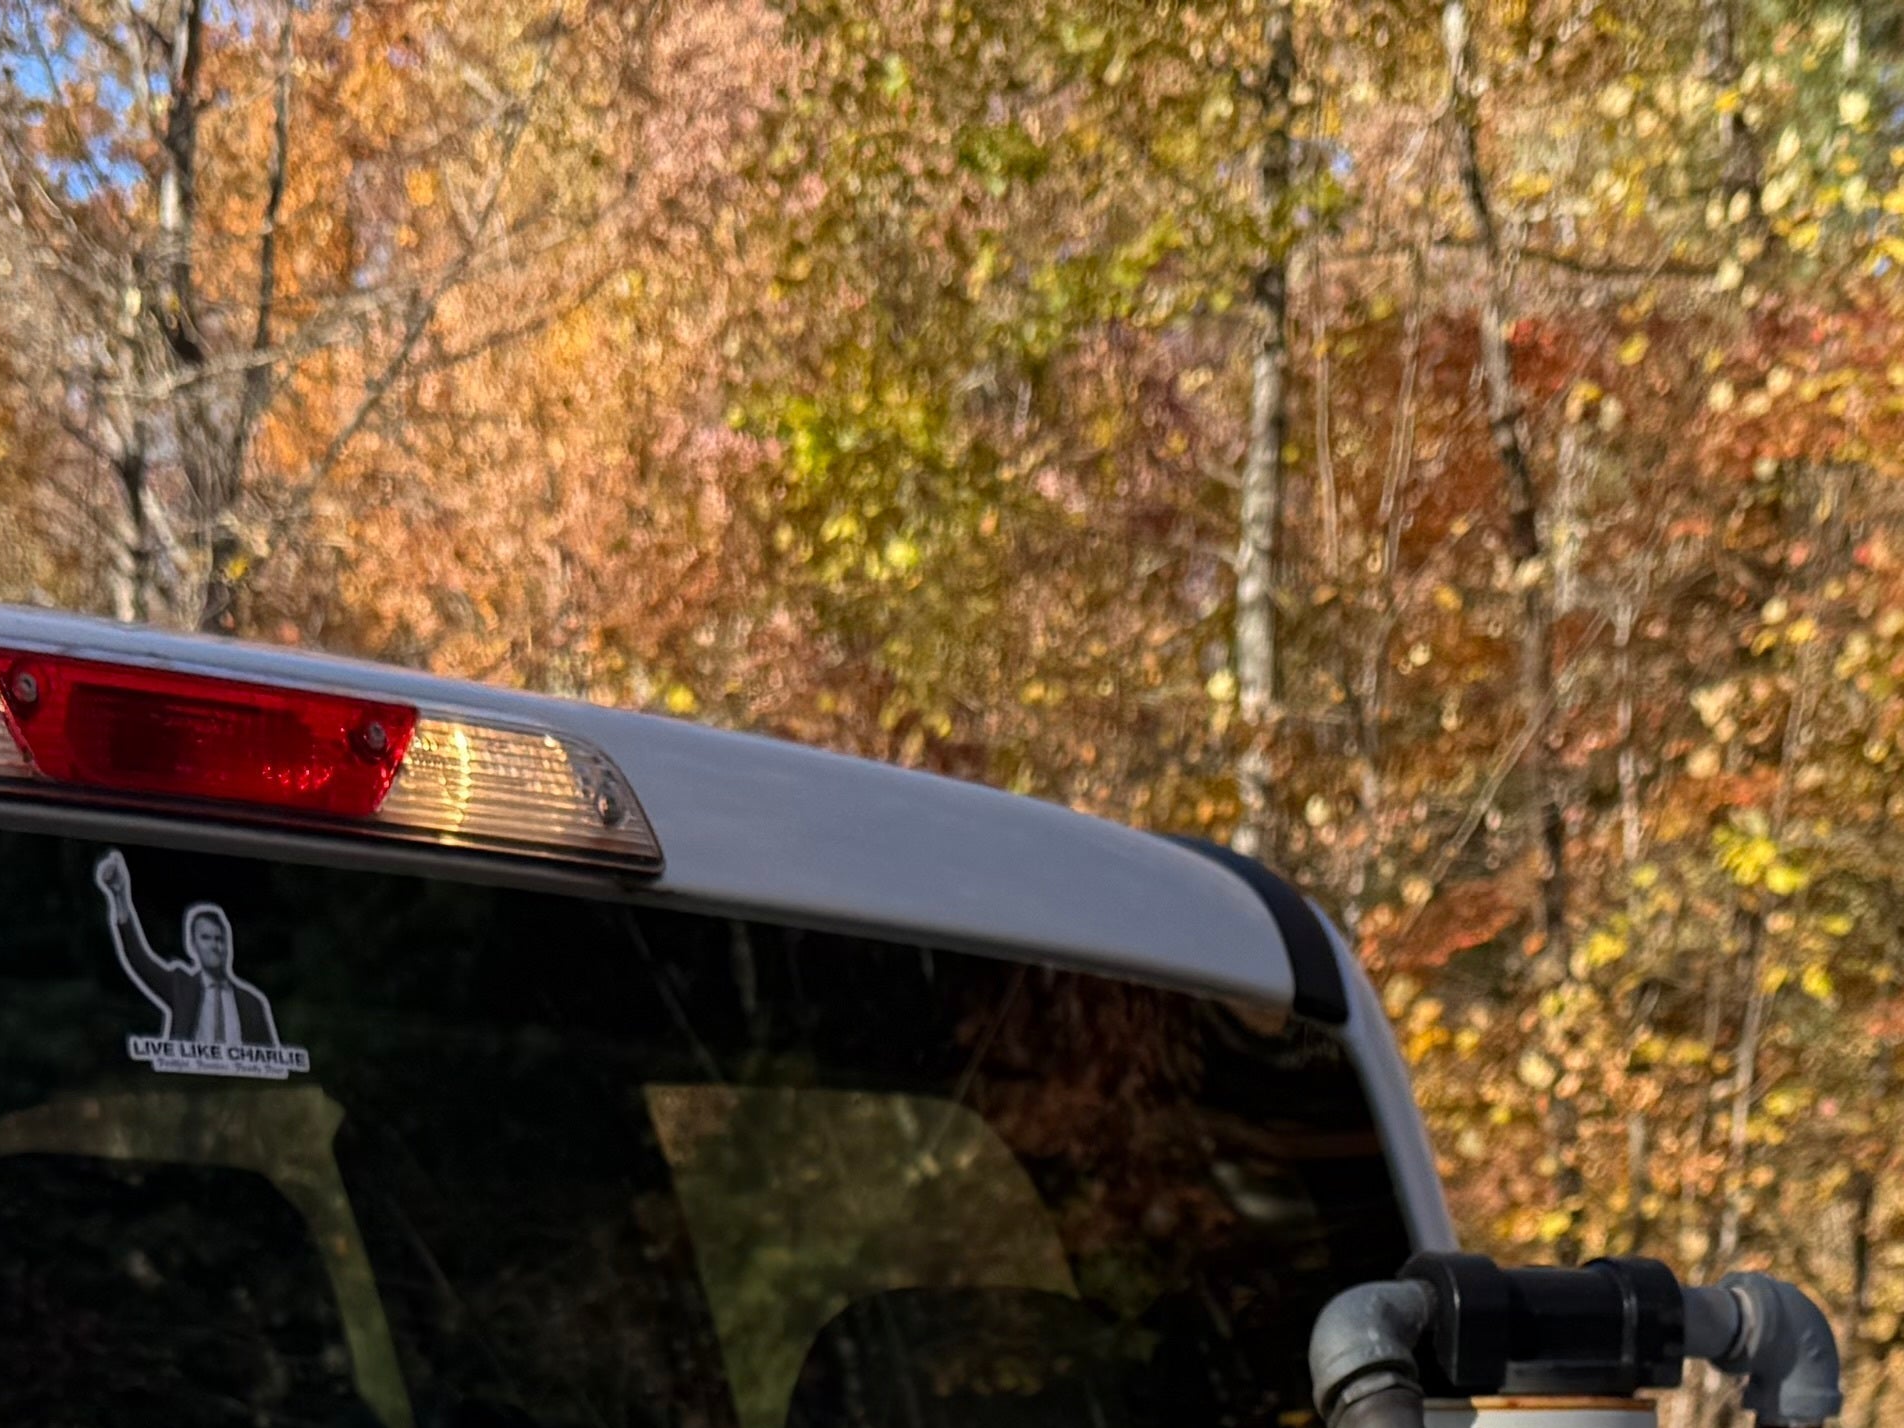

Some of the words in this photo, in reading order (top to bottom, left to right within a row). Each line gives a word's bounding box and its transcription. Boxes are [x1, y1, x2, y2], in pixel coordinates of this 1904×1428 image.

[132, 1040, 175, 1057] LIVE
[180, 1043, 222, 1060] LIKE
[227, 1047, 306, 1067] CHARLIE
